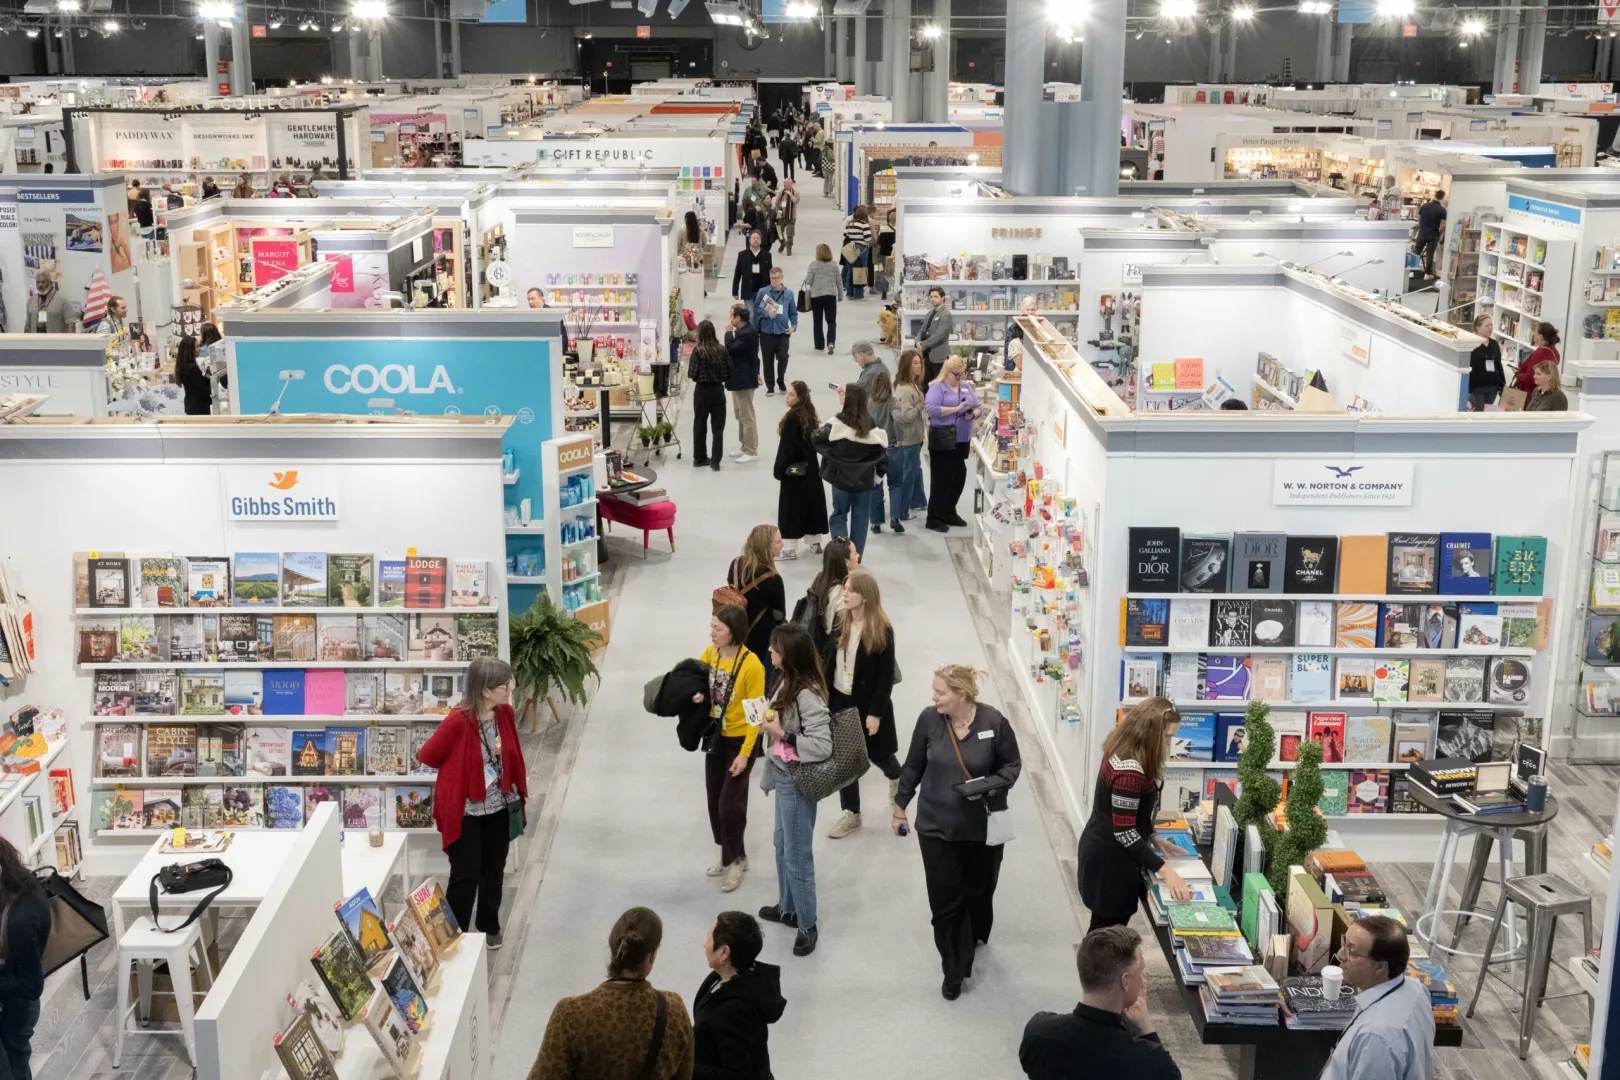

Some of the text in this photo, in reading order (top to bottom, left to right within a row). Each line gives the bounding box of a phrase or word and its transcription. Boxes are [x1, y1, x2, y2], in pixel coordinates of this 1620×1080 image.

[220, 97, 330, 110] COLLECTIVE
[293, 132, 336, 140] HARDWARE
[1260, 138, 1282, 146] Pauper
[553, 149, 653, 160] GIFT REPUBLIC
[991, 228, 1043, 238] FRINGE
[330, 267, 350, 287] New
[323, 364, 456, 394] COOLA
[560, 447, 590, 463] COOLA
[1289, 492, 1328, 500] Independent
[1329, 492, 1362, 500] Publishers
[1363, 492, 1380, 500] Since
[231, 496, 336, 517] Gibbs Smith
[1390, 536, 1438, 547] Karl Lagerfeld
[1244, 542, 1278, 554] DIOR
[410, 560, 441, 569] LODGE
[1138, 562, 1170, 574] DIOR
[1298, 654, 1329, 662] SUPER
[270, 680, 300, 689] MOOD
[156, 728, 188, 736] CABIN
[156, 736, 188, 744] STYLE
[400, 812, 428, 820] TULIPS
[414, 885, 430, 906] SURF
[1287, 986, 1356, 997] INDO
